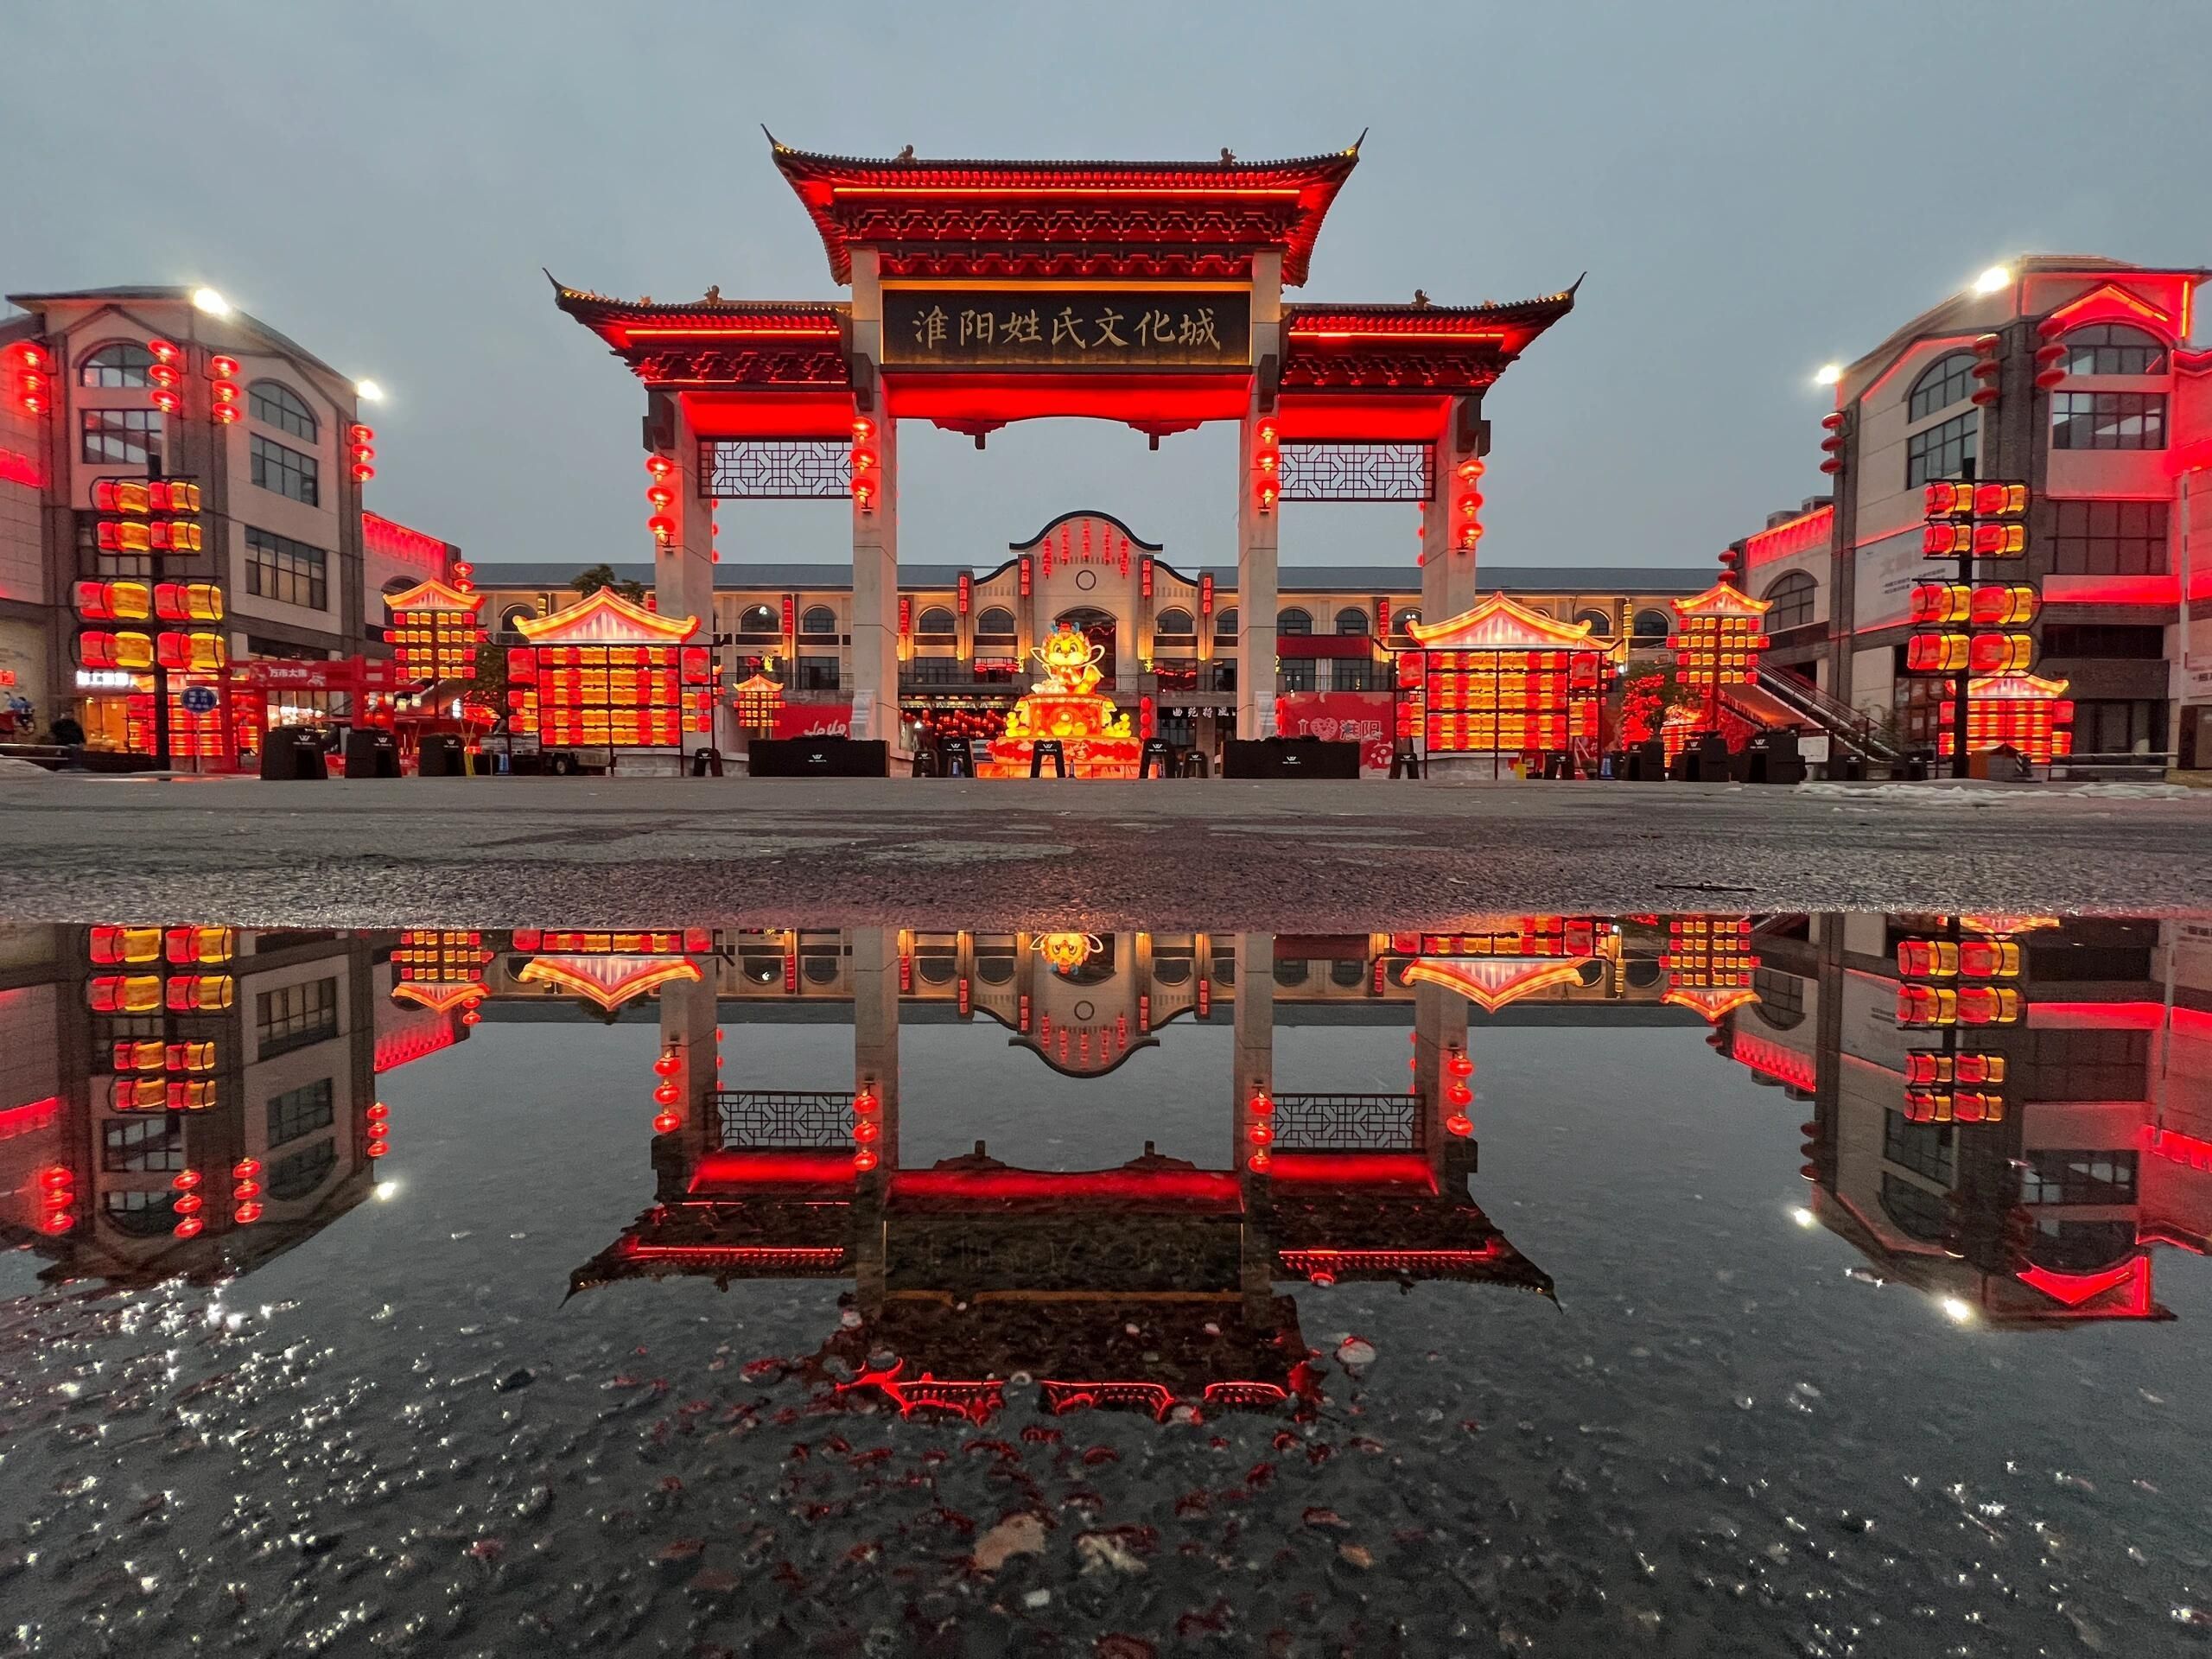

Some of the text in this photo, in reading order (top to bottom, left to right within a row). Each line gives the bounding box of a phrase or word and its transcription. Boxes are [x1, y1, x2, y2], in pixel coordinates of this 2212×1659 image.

[912, 304, 1221, 351] 淮阳姓氏文化城
[1339, 719, 1382, 741] 淮阳
